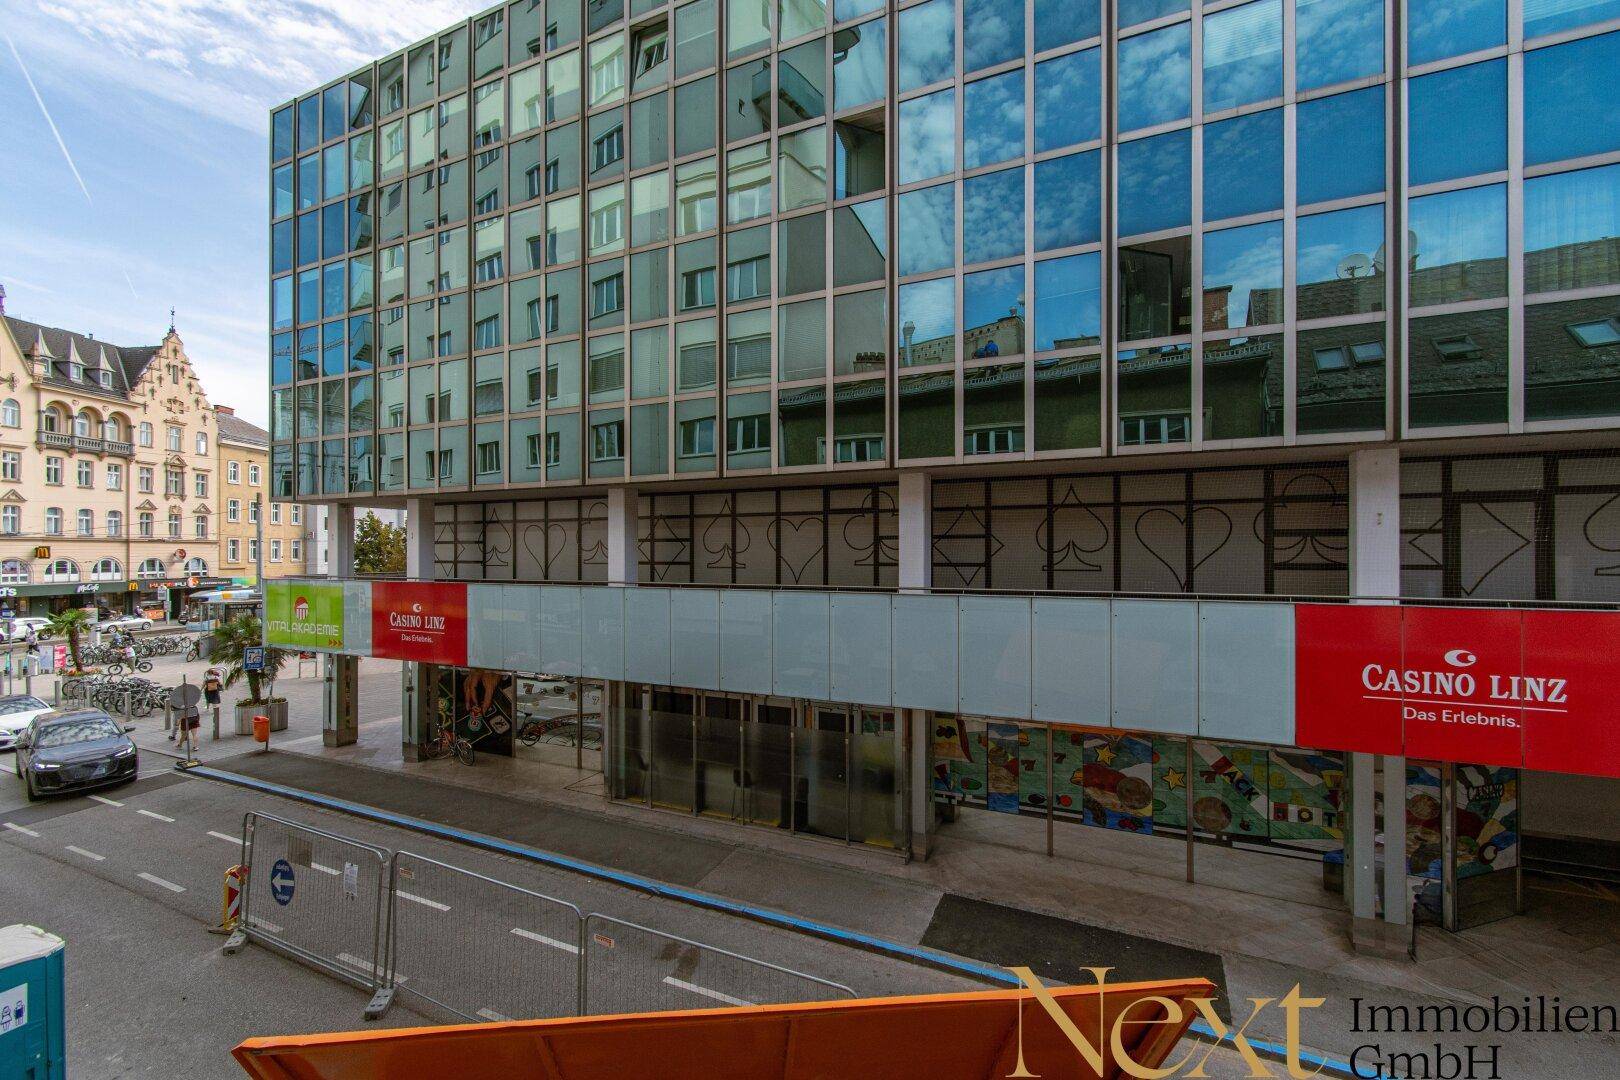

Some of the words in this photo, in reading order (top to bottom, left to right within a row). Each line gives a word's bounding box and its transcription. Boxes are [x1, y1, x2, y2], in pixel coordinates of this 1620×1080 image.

[267, 620, 340, 636] VITALAKADEMIE
[390, 611, 421, 628] CASINO
[425, 616, 445, 629] LINZ
[401, 634, 411, 642] Das
[1362, 664, 1475, 697] CASINO
[1490, 675, 1568, 704] LINZ
[1404, 707, 1436, 721] Das
[1442, 710, 1521, 728] Erlebnis.
